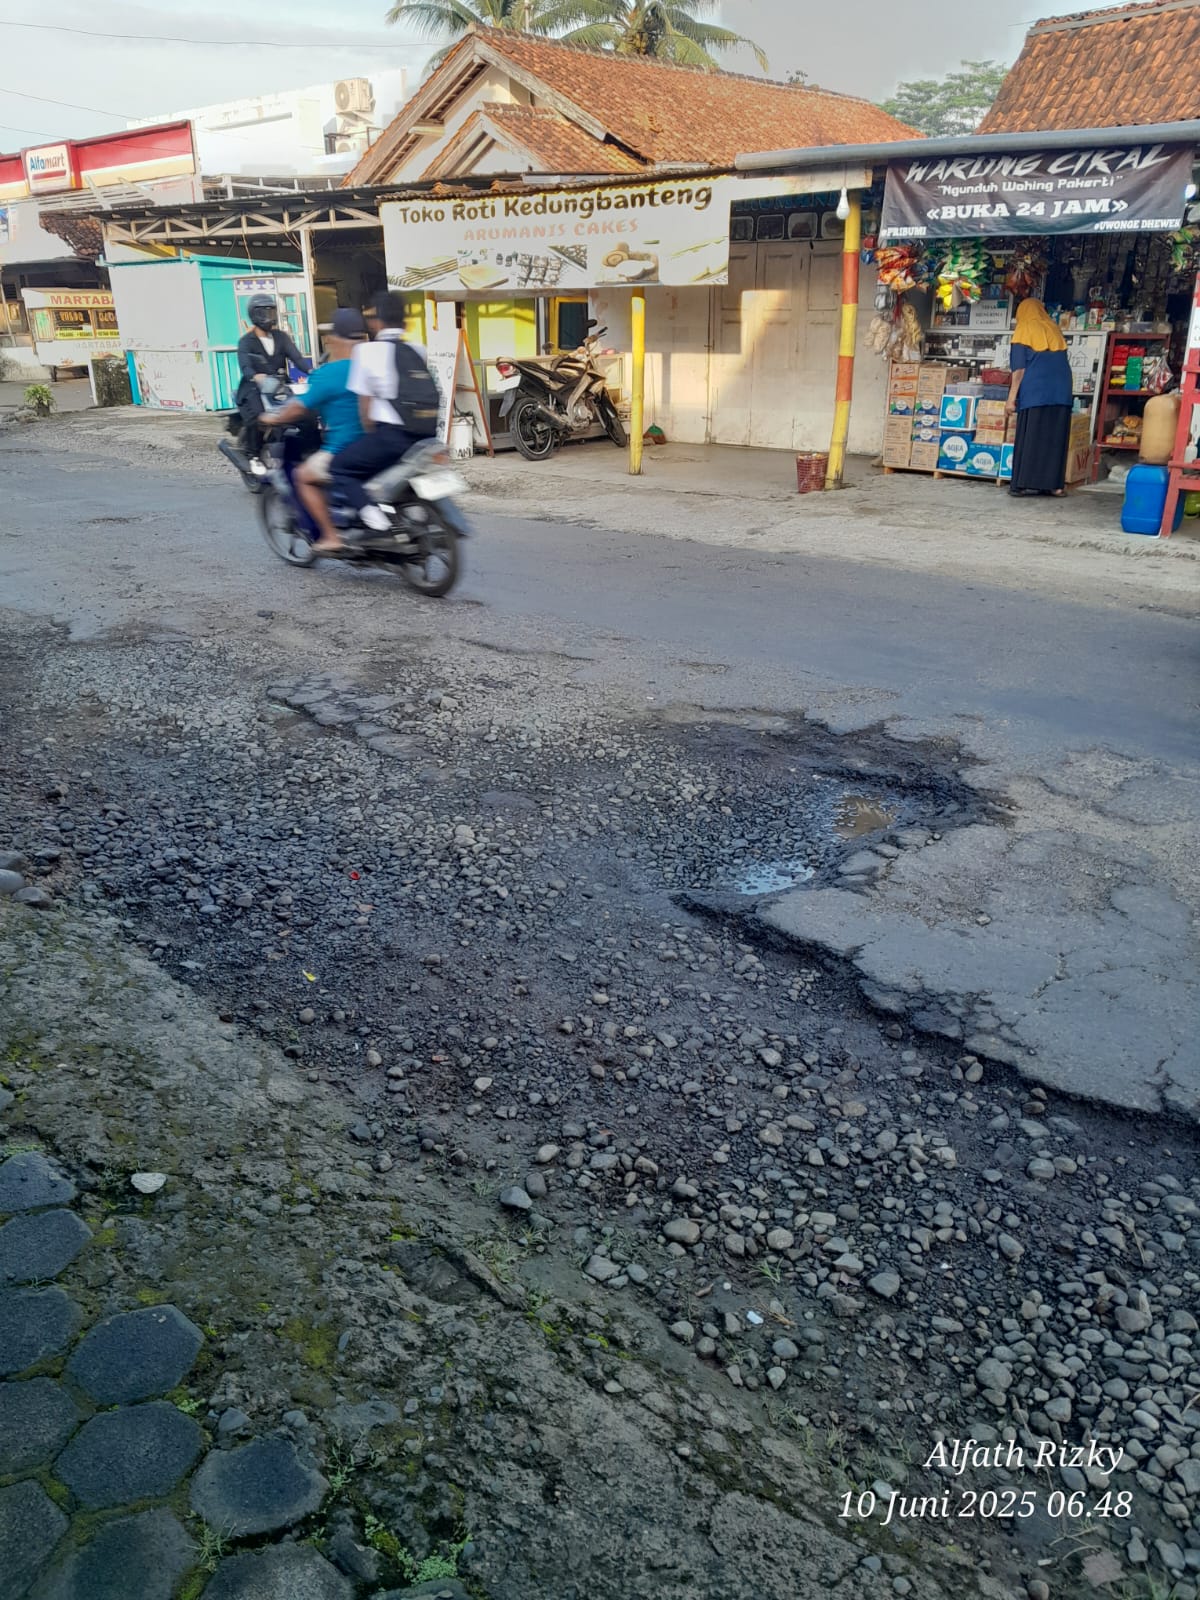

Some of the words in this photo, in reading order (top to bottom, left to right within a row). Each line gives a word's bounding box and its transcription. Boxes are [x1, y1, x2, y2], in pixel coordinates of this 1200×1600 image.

[30, 153, 65, 171] Alfamart
[905, 153, 1042, 183] WARUNG
[1047, 144, 1171, 176] CIKAL
[1003, 180, 1054, 192] Wohing
[400, 206, 445, 224] Toko
[452, 201, 496, 221] Roti
[505, 186, 712, 219] Kedungbanteng
[1016, 201, 1045, 216] 24
[463, 223, 566, 241] ARUMANIS
[574, 218, 638, 236] CAKES
